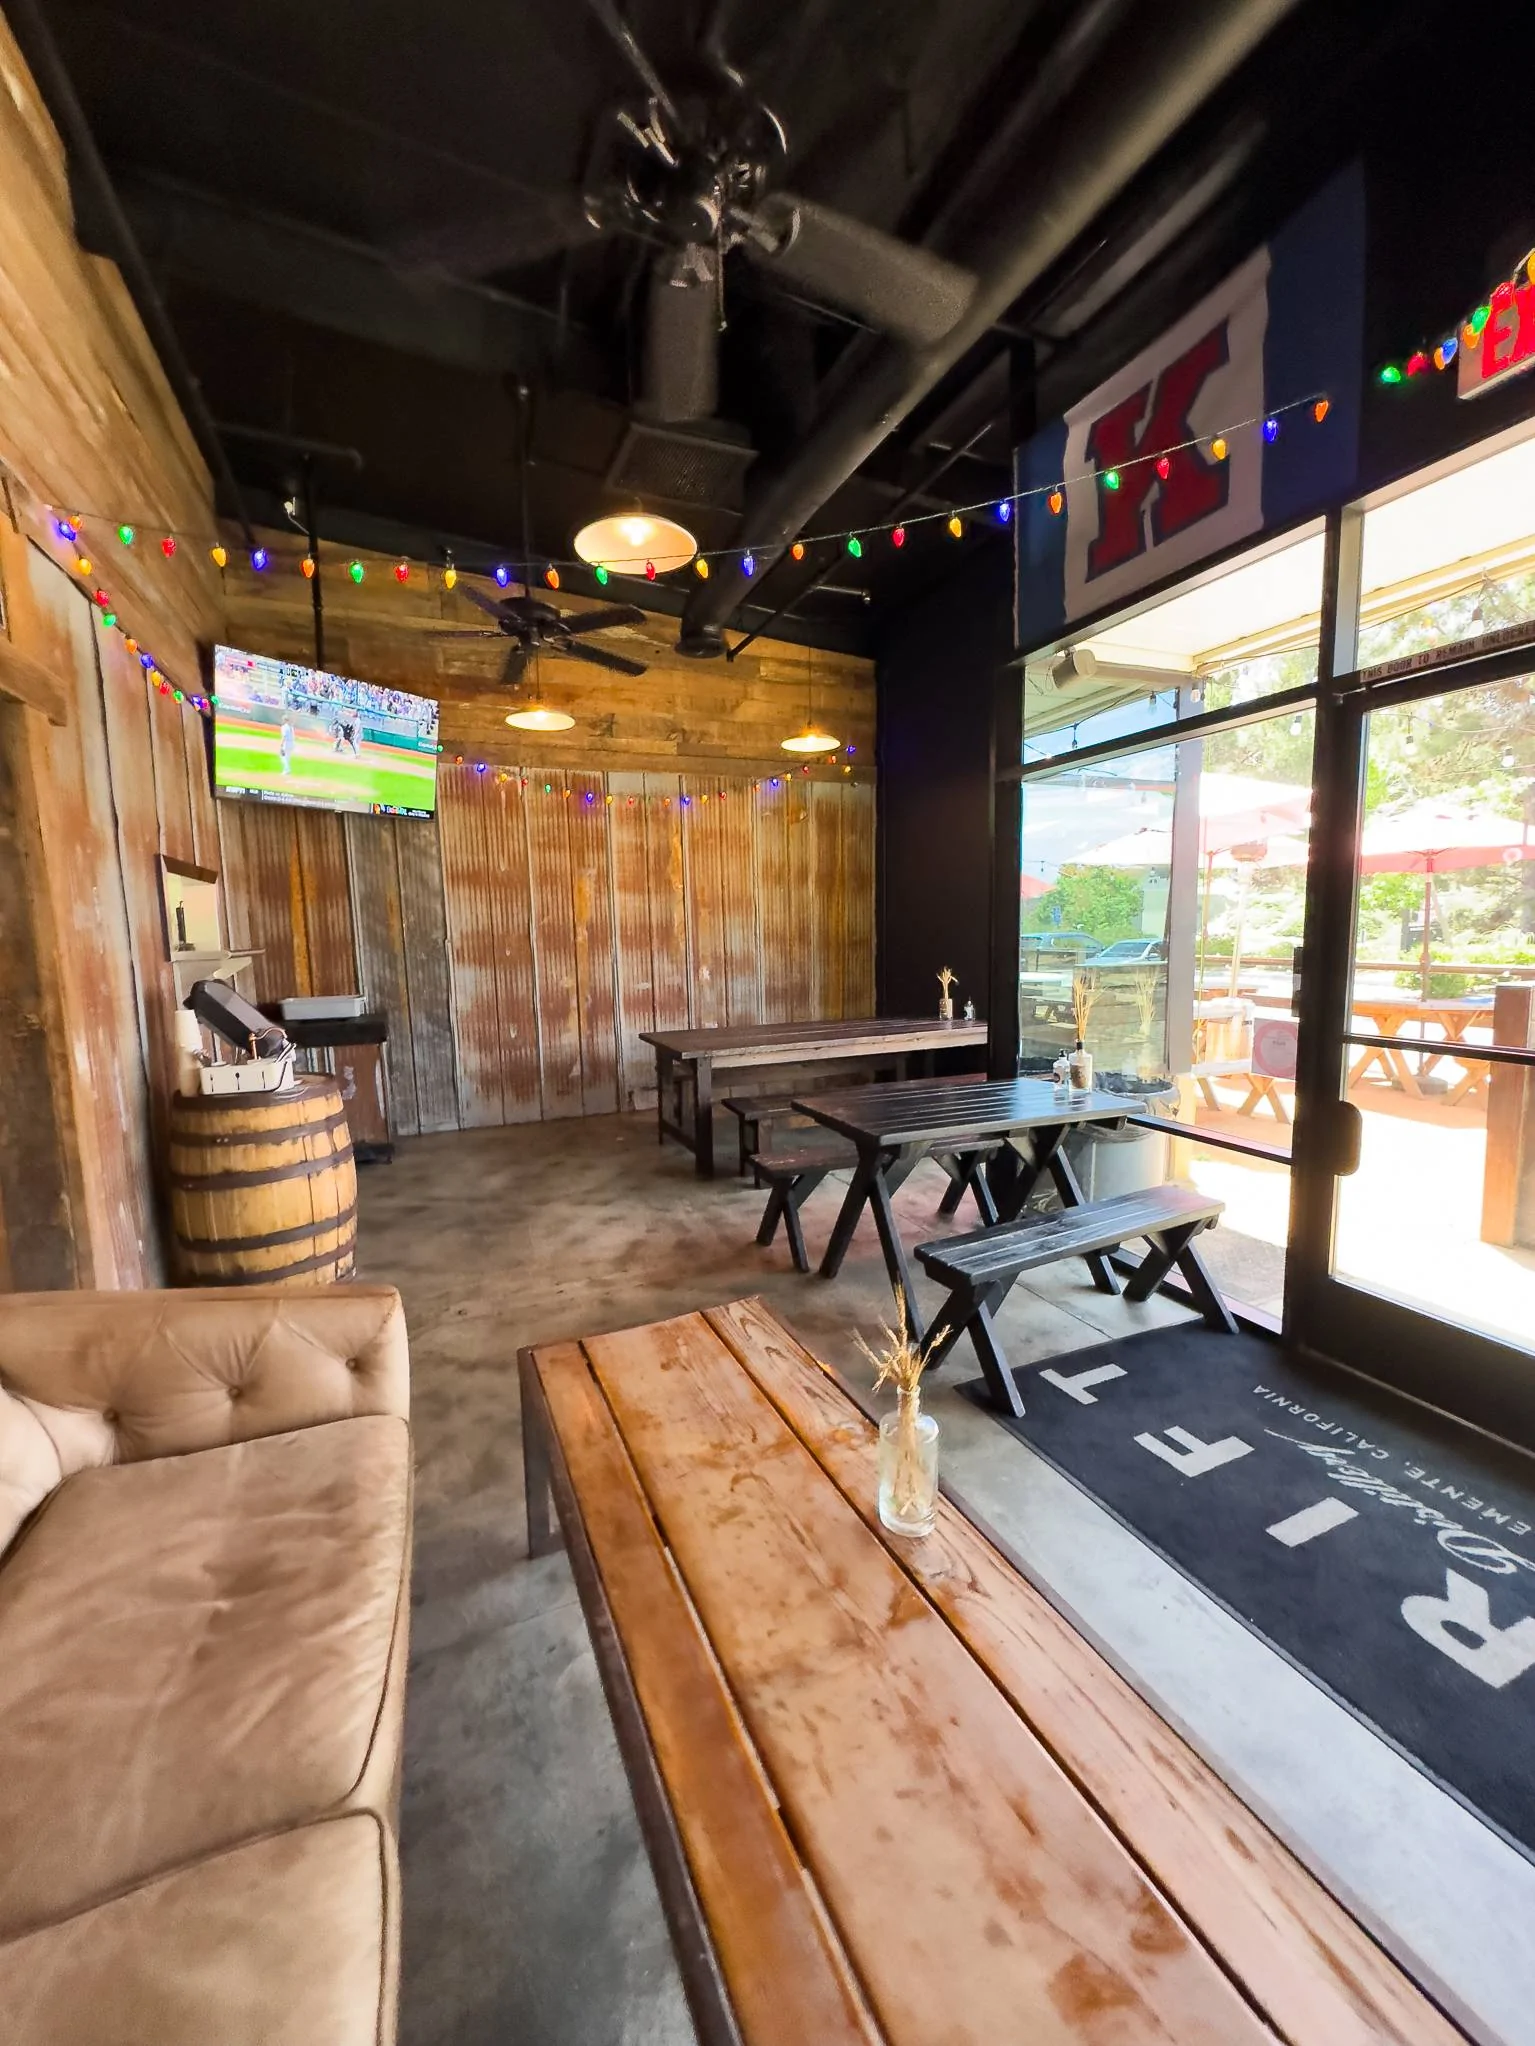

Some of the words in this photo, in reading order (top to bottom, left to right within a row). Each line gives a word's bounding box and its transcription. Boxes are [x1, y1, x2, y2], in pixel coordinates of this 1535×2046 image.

[1085, 319, 1229, 583] K
[1362, 668, 1382, 679] THIS
[1387, 660, 1412, 674] DOOR
[1418, 654, 1430, 666] TO
[1436, 640, 1475, 662] REMAIN
[1252, 1384, 1390, 1460] CALIFORNIA
